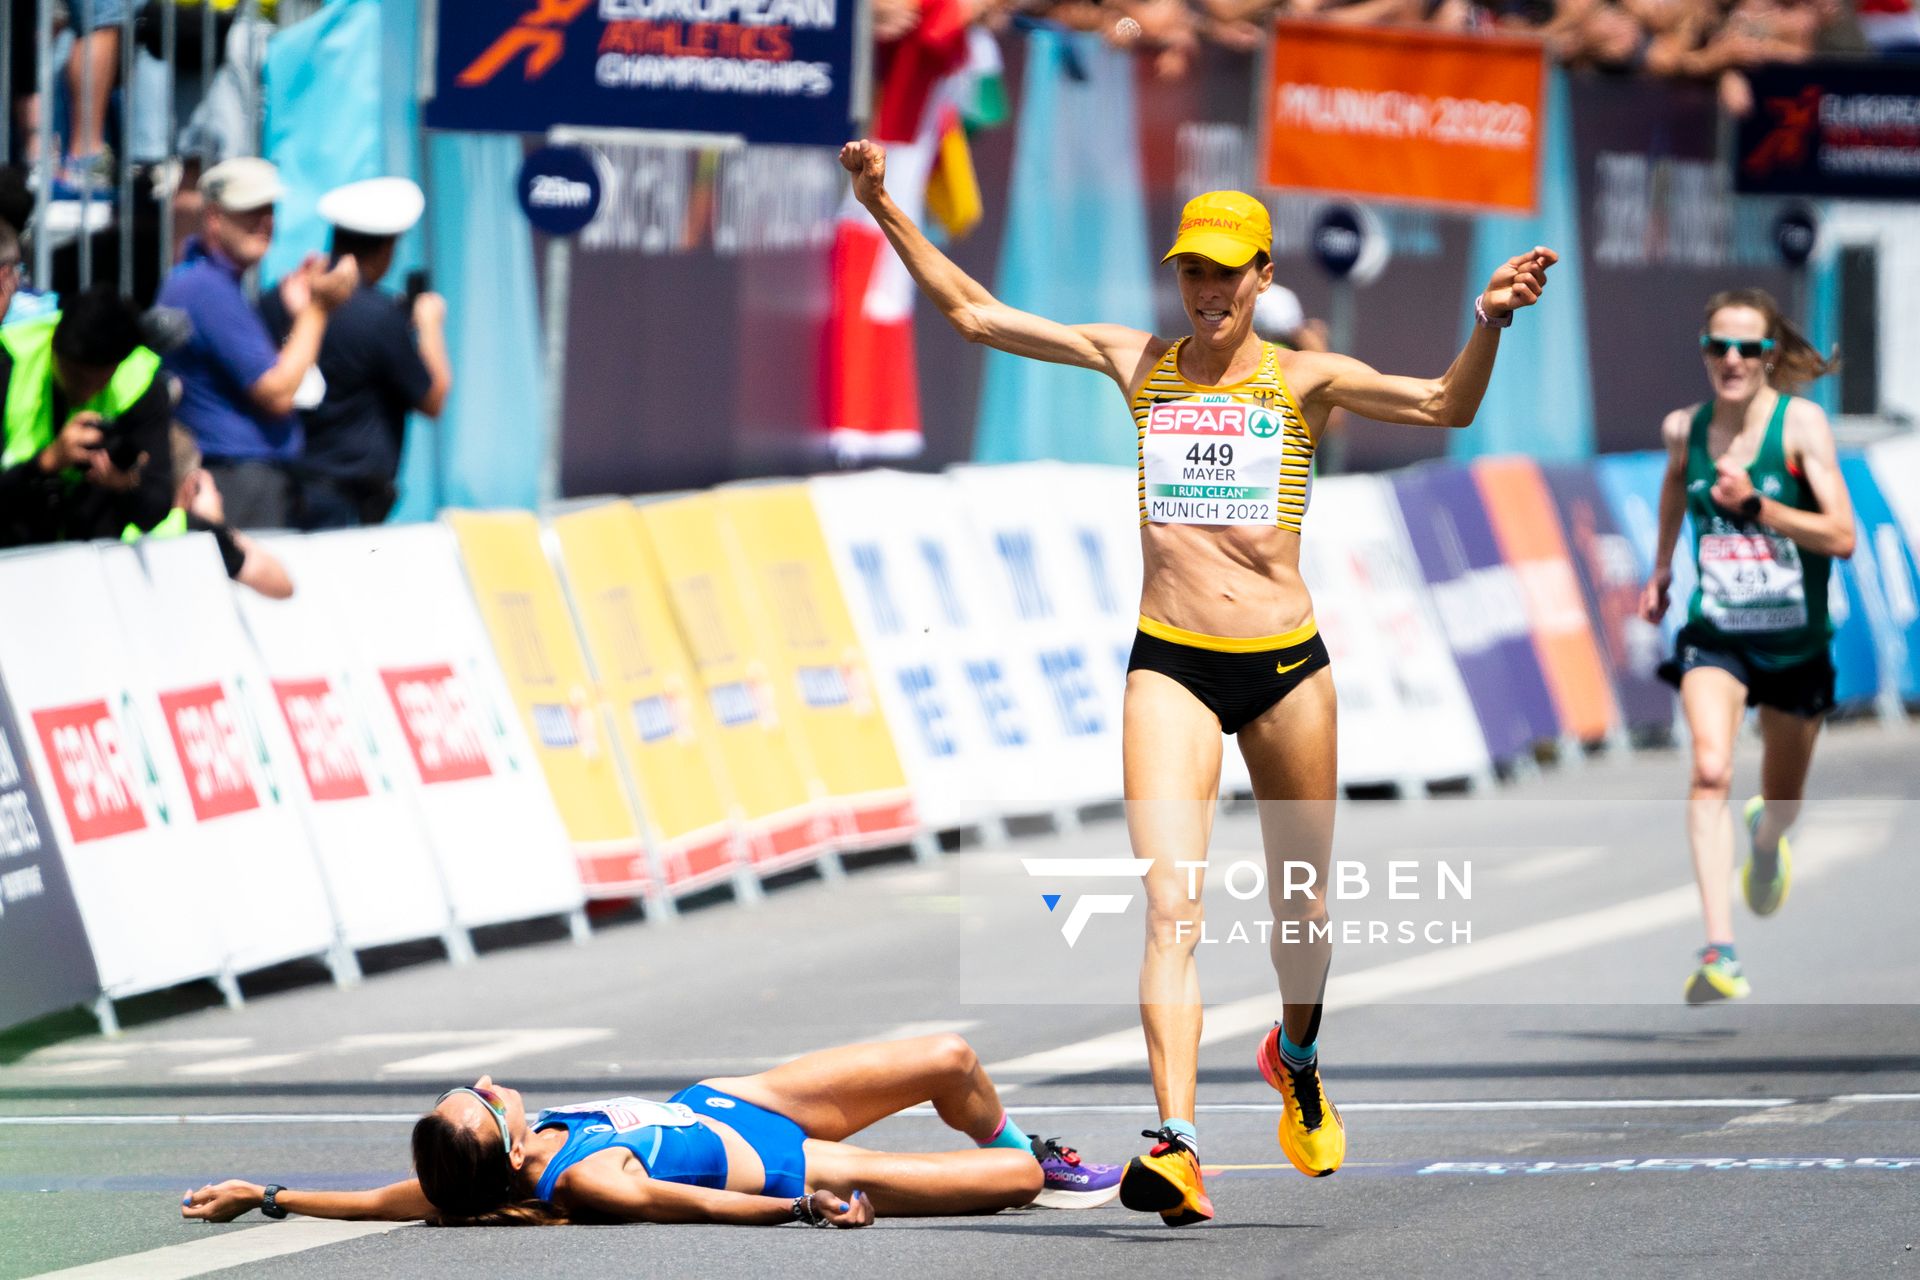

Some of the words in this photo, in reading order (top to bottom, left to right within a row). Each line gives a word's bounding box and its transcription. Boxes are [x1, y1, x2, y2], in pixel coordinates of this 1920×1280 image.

[597, 19, 792, 61] ATHLETICS
[595, 52, 832, 97] CHAMPIONSHIPS
[1276, 82, 1430, 138] MUNICH
[1431, 96, 1532, 148] 2022
[1181, 217, 1241, 232] GERMANY
[1152, 409, 1243, 432] SPAR
[1186, 442, 1233, 466] 449
[1183, 468, 1235, 481] MAYER
[1179, 487, 1203, 497] RUN
[1153, 501, 1219, 519] MUNICH
[1226, 503, 1269, 520] 2022
[1047, 1169, 1089, 1184] balance
